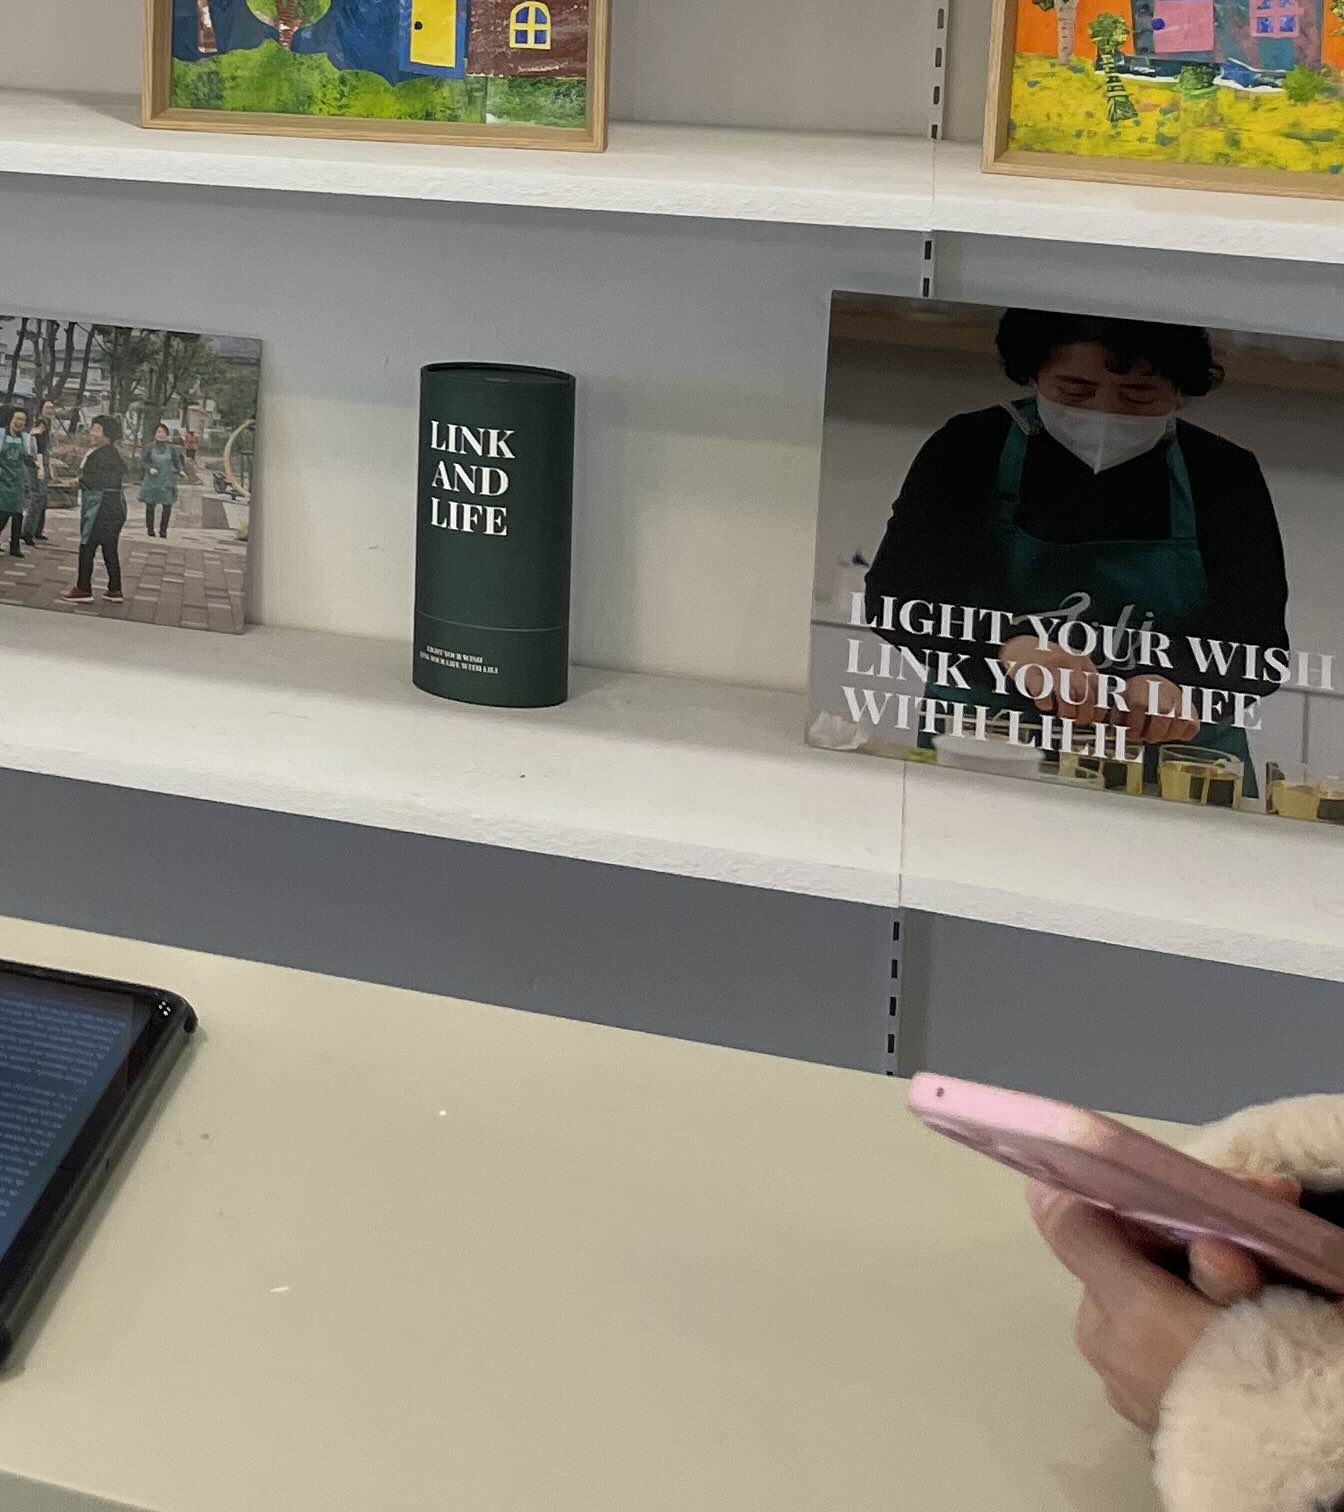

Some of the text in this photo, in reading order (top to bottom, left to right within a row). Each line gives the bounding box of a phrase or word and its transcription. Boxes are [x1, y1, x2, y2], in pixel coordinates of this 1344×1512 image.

[430, 419, 515, 460] LINK
[431, 459, 510, 497] AND
[430, 496, 508, 537] LIFE
[849, 592, 1335, 691] LIGHT YOUR WISH
[845, 638, 1263, 731] LINK YOUR LIFE
[841, 686, 990, 741] WITH
